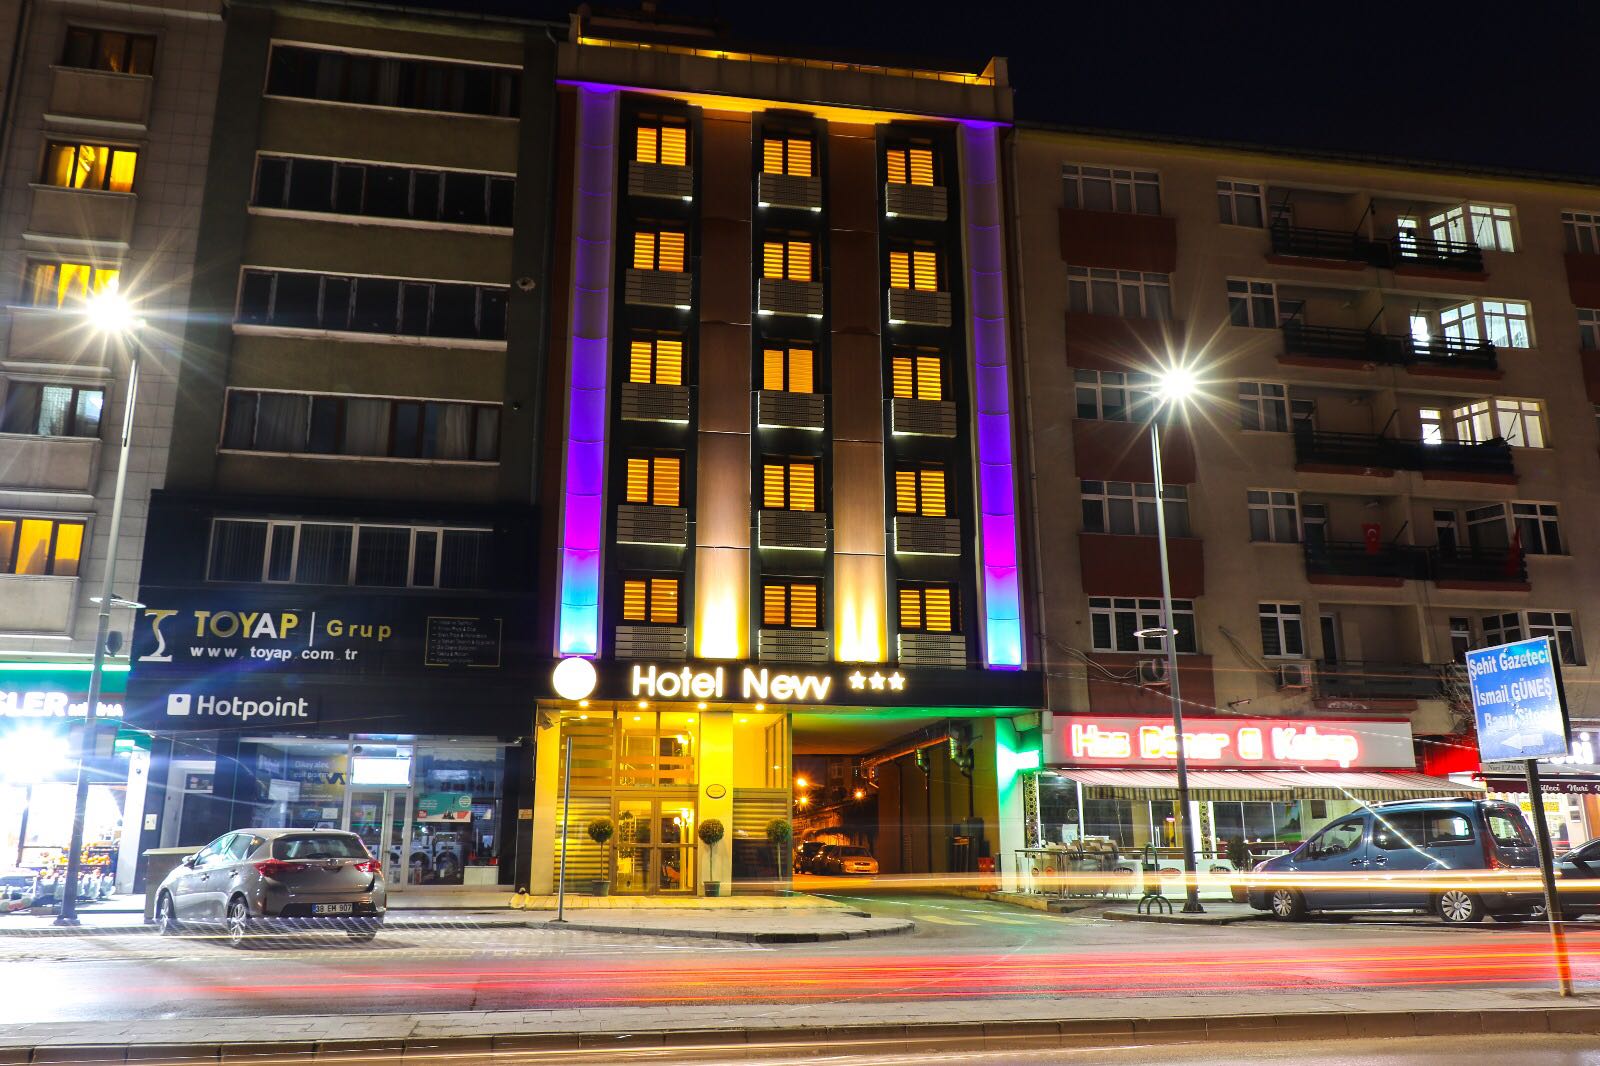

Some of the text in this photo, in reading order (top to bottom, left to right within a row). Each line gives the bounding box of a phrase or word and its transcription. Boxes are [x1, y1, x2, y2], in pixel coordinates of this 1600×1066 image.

[194, 610, 392, 642] TOYAP Grup
[1469, 644, 1550, 681] Şehit Gazeteci
[631, 664, 724, 699] Hotel
[1475, 677, 1553, 707] İsmail GÜNEŞ
[196, 695, 309, 721] Hotpoint
